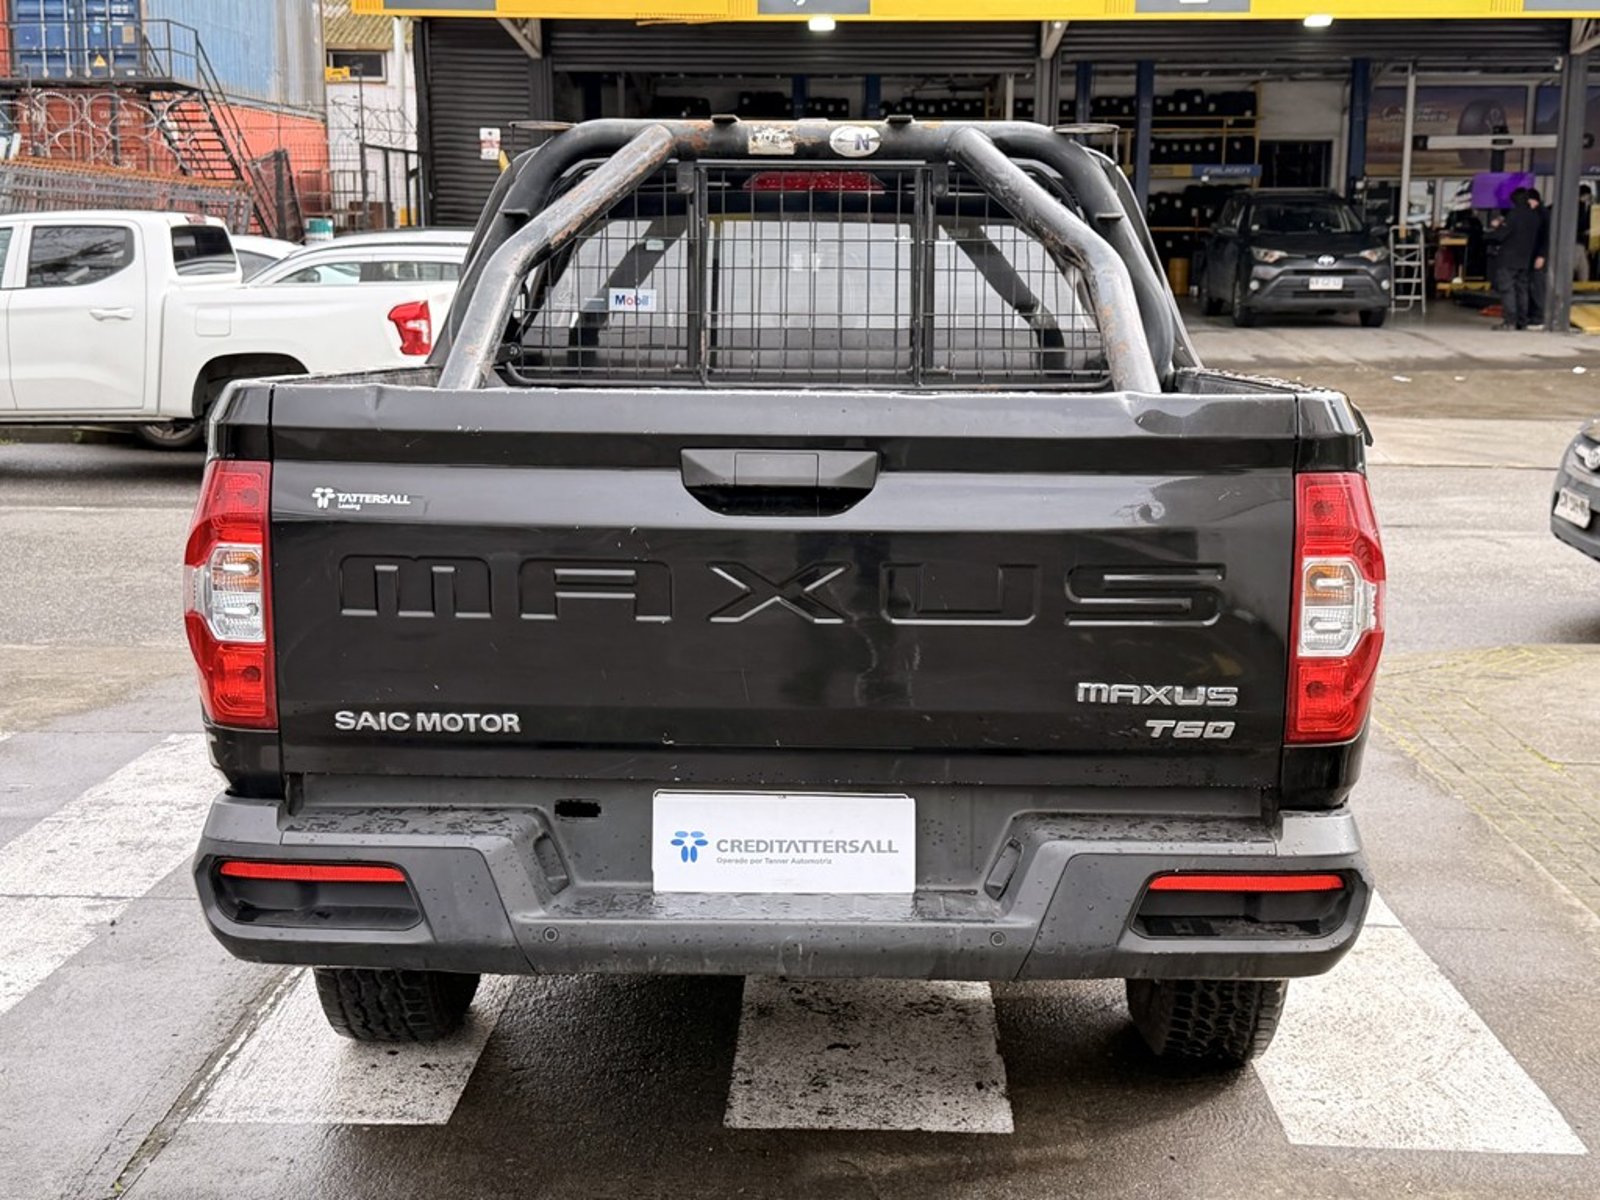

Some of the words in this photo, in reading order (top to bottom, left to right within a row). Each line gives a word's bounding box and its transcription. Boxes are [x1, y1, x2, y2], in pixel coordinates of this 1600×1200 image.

[337, 492, 411, 504] TATTERSALL
[340, 554, 1226, 627] MAXUS
[1077, 682, 1238, 707] MAXUS
[334, 711, 411, 732] SAIC
[416, 713, 521, 733] MOTOR
[1145, 719, 1236, 739] T60
[716, 839, 899, 854] CREDITATTERSALL
[749, 858, 763, 866] por
